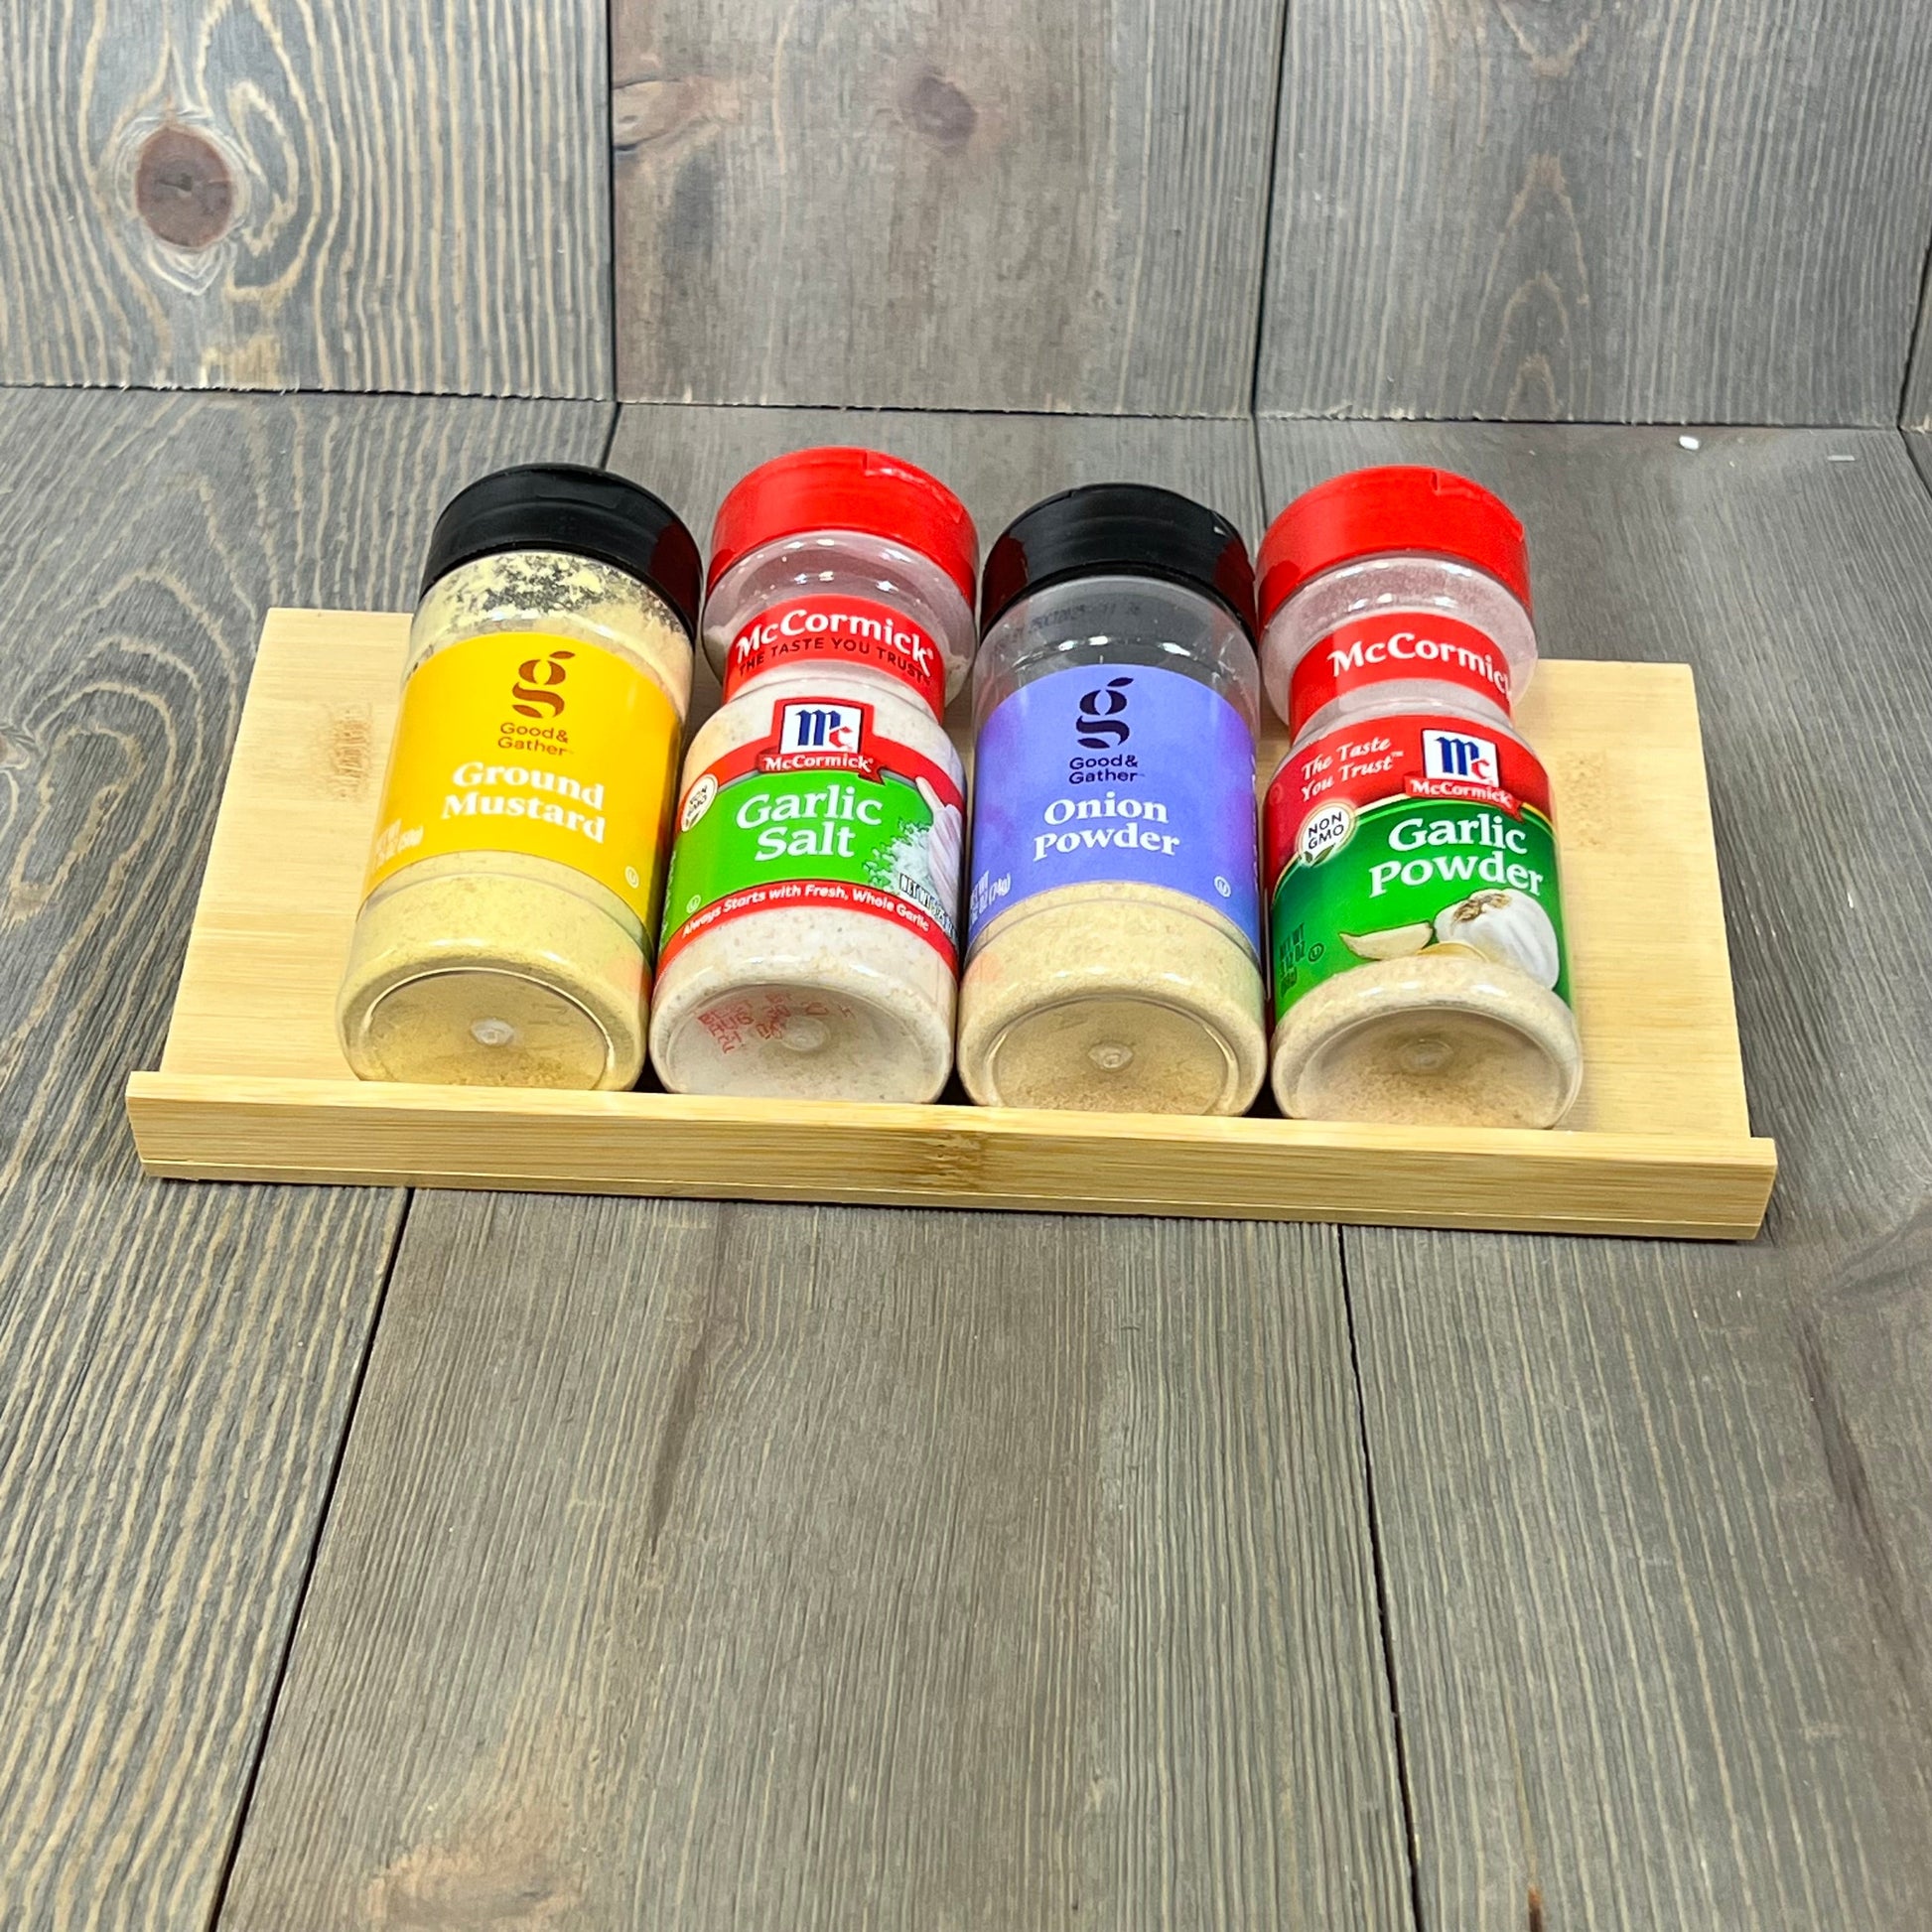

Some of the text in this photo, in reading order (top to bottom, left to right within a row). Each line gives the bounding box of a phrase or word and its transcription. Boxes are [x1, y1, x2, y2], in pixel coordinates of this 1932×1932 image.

[736, 609, 931, 677] McCormick
[771, 636, 824, 658] TASTE
[830, 636, 871, 655] YOU
[763, 754, 873, 773] McCormick
[1302, 737, 1392, 780] The Taste
[453, 760, 606, 811] Ground
[736, 783, 884, 830] Garlic
[1302, 775, 1333, 802] You
[1410, 778, 1513, 805] McCormick
[441, 791, 607, 844] Mustard
[1043, 790, 1170, 826] Onion
[1309, 812, 1342, 839] NON
[754, 821, 857, 863] Salt
[1032, 822, 1180, 863] Powder
[1309, 824, 1344, 850] GMO
[1387, 812, 1529, 855] Garlic
[1368, 850, 1544, 899] Powder
[682, 905, 722, 938] Always
[722, 892, 765, 912] Starts
[768, 885, 801, 899] with
[804, 884, 849, 901] Fresh,
[853, 890, 895, 912] Whole
[896, 902, 930, 932] Garlic
